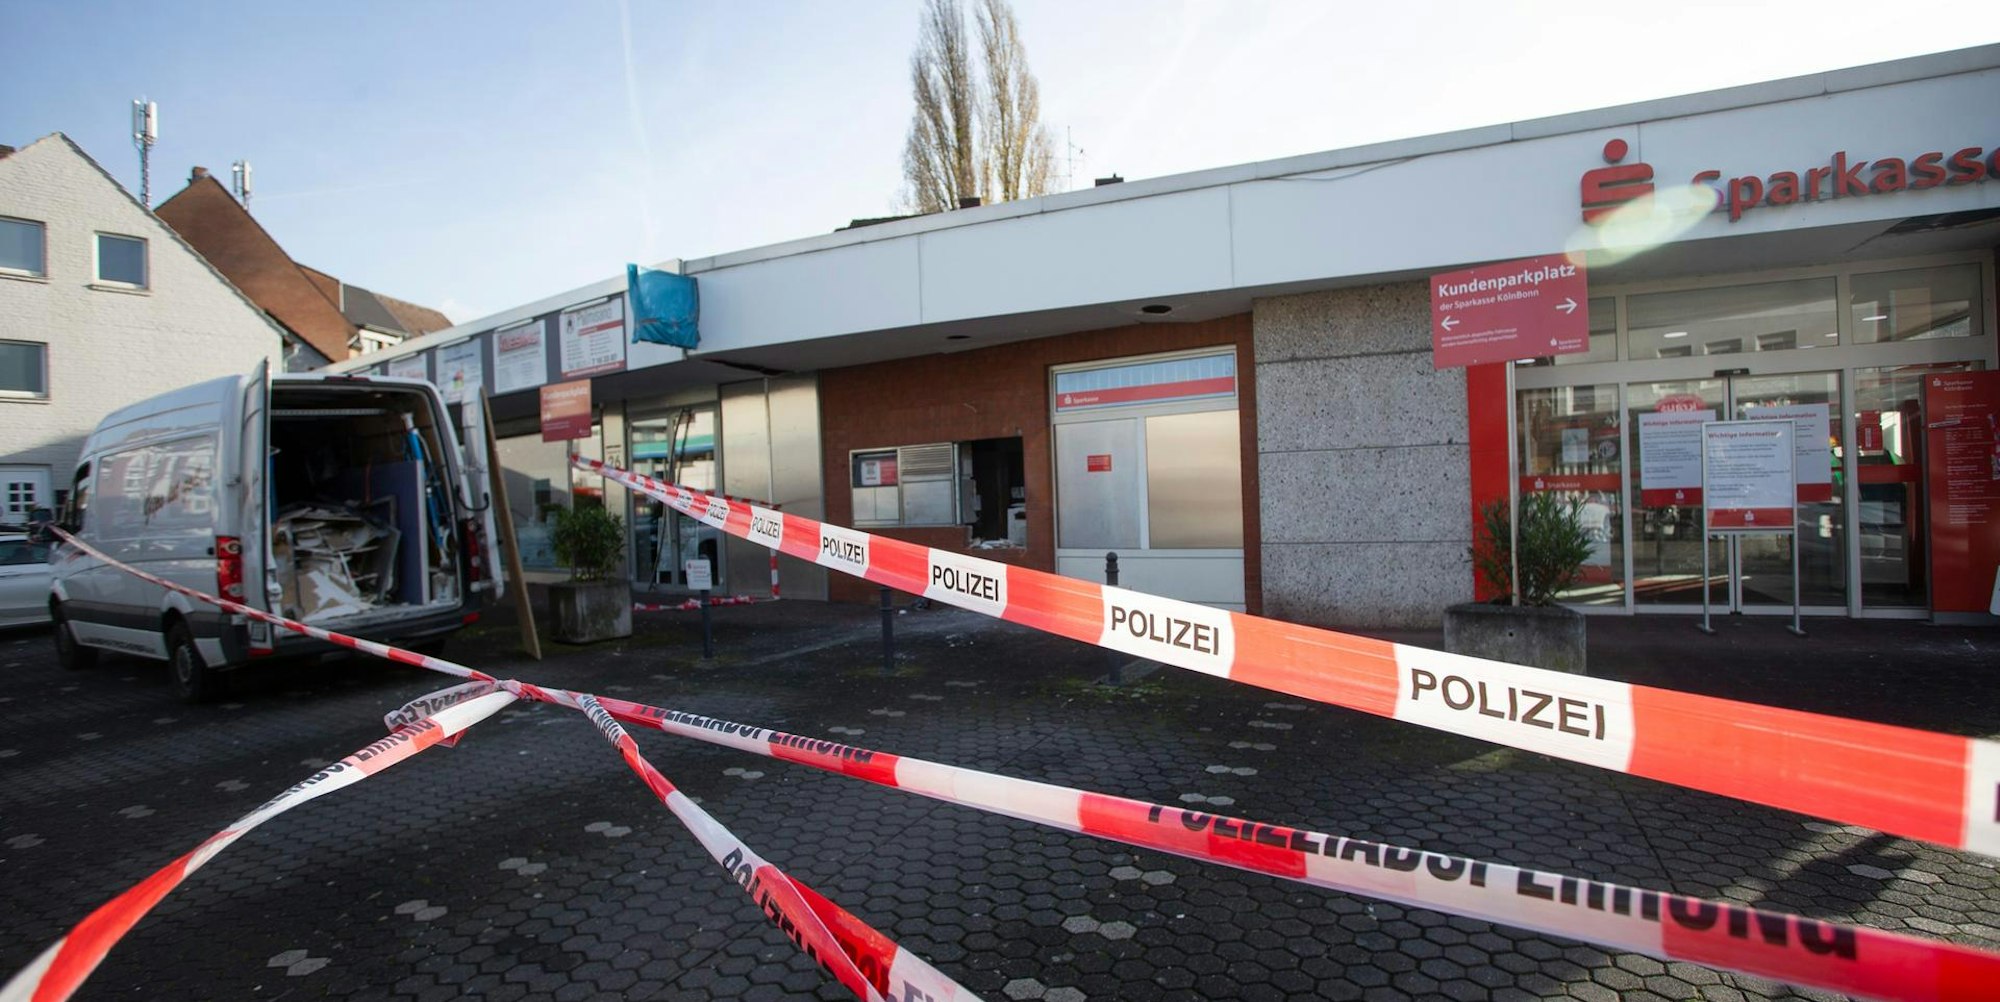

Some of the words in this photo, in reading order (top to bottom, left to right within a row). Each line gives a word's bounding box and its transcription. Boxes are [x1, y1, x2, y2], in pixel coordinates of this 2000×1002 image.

[1438, 264, 1576, 298] Kundenparkplatz
[1439, 302, 1453, 311] der
[1454, 295, 1496, 309] Sparkasse
[1497, 289, 1540, 302] KölnBonn
[752, 517, 780, 538] POLIZEI
[822, 536, 865, 566] POLIZEI
[932, 564, 999, 602] POLIZEI
[1111, 605, 1219, 655] POLIZEI
[1411, 668, 1605, 741] POLIZEI
